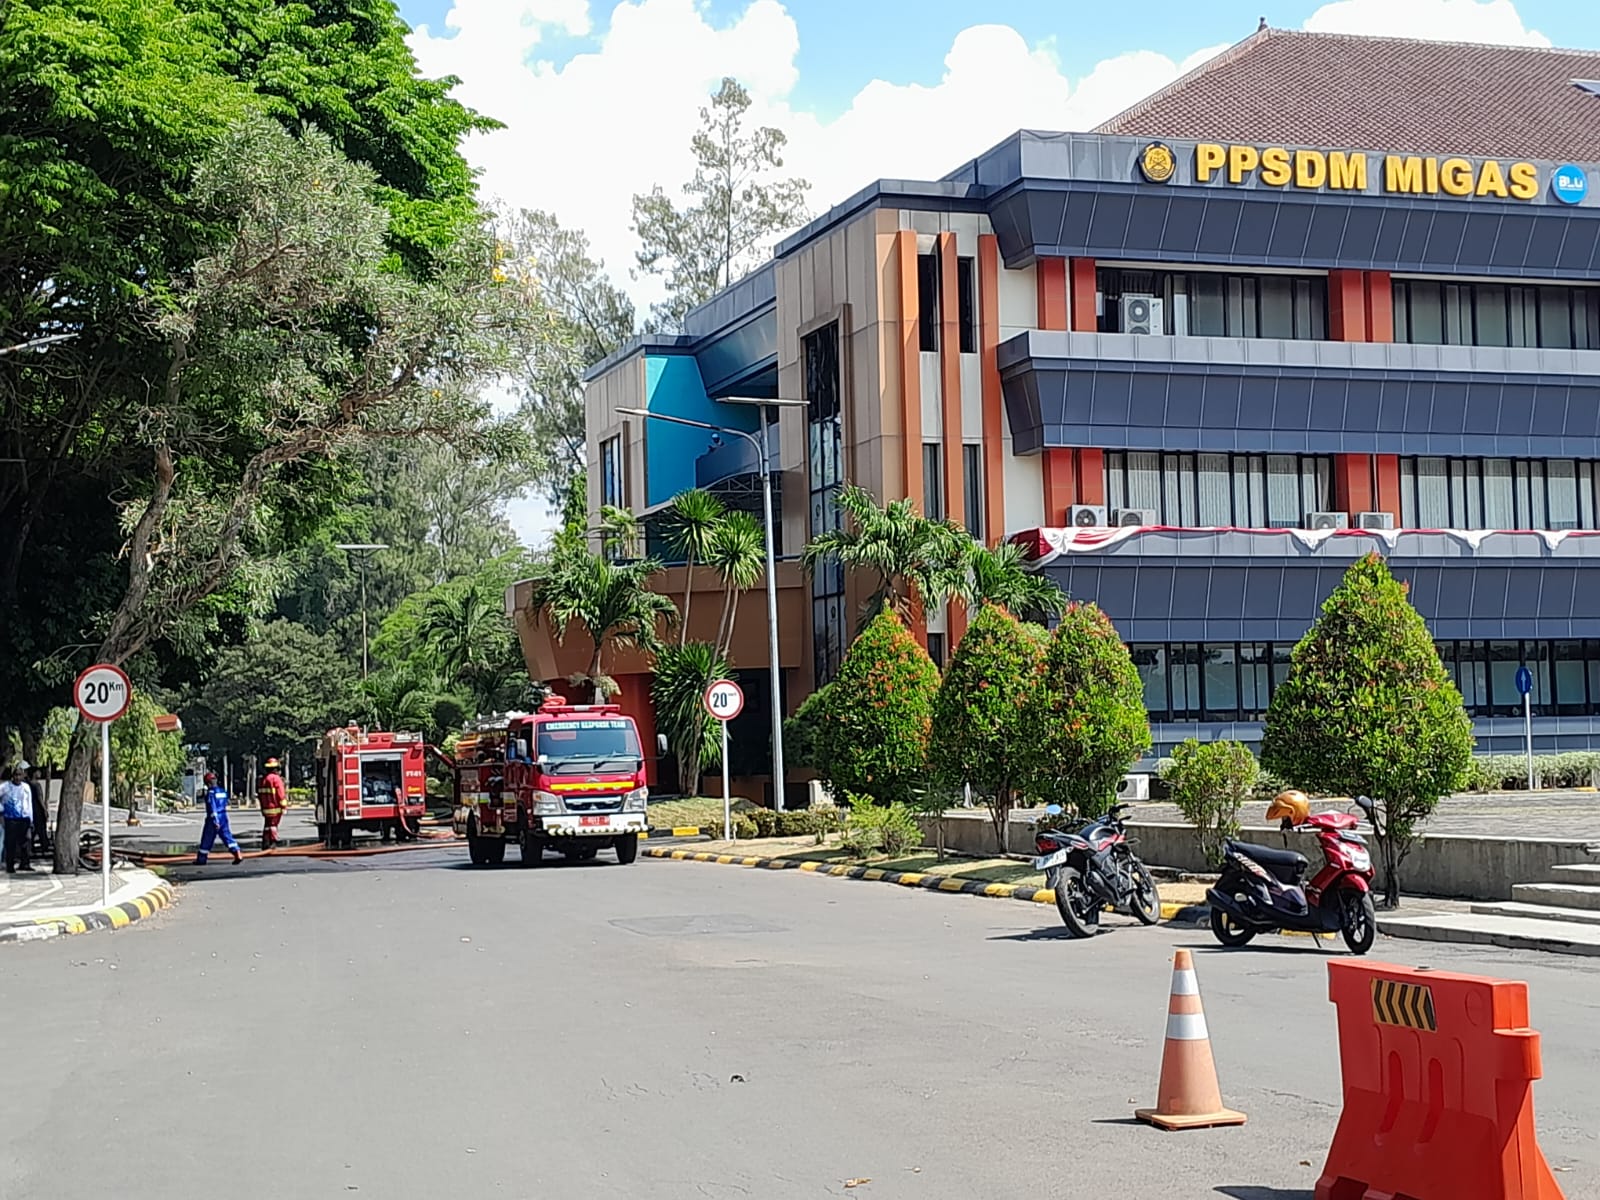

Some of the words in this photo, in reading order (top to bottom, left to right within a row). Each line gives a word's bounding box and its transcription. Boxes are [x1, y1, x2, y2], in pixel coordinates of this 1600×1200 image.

[1196, 143, 1368, 190] PPSDM
[1385, 154, 1539, 200] MIGAS
[84, 682, 109, 704] 20
[712, 692, 728, 708] 20
